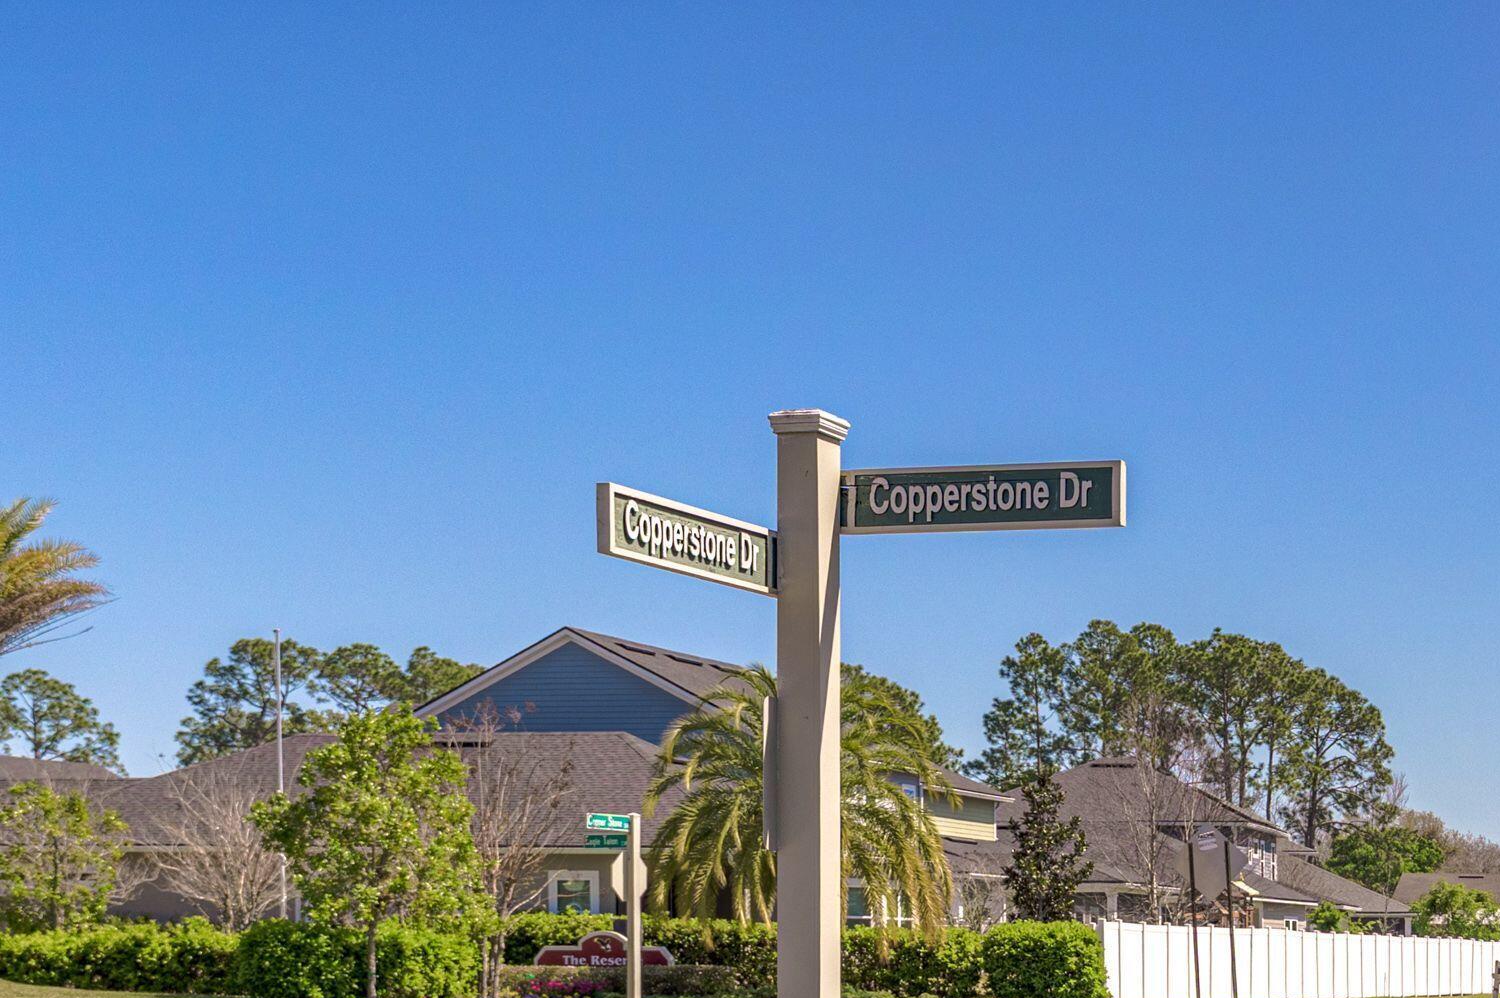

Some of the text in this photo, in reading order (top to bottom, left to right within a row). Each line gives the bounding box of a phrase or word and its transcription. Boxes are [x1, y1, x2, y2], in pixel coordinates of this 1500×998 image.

[870, 471, 1093, 523] Copperstone Dr
[624, 499, 760, 572] Copperstone Dr
[562, 955, 628, 966] The Reser
